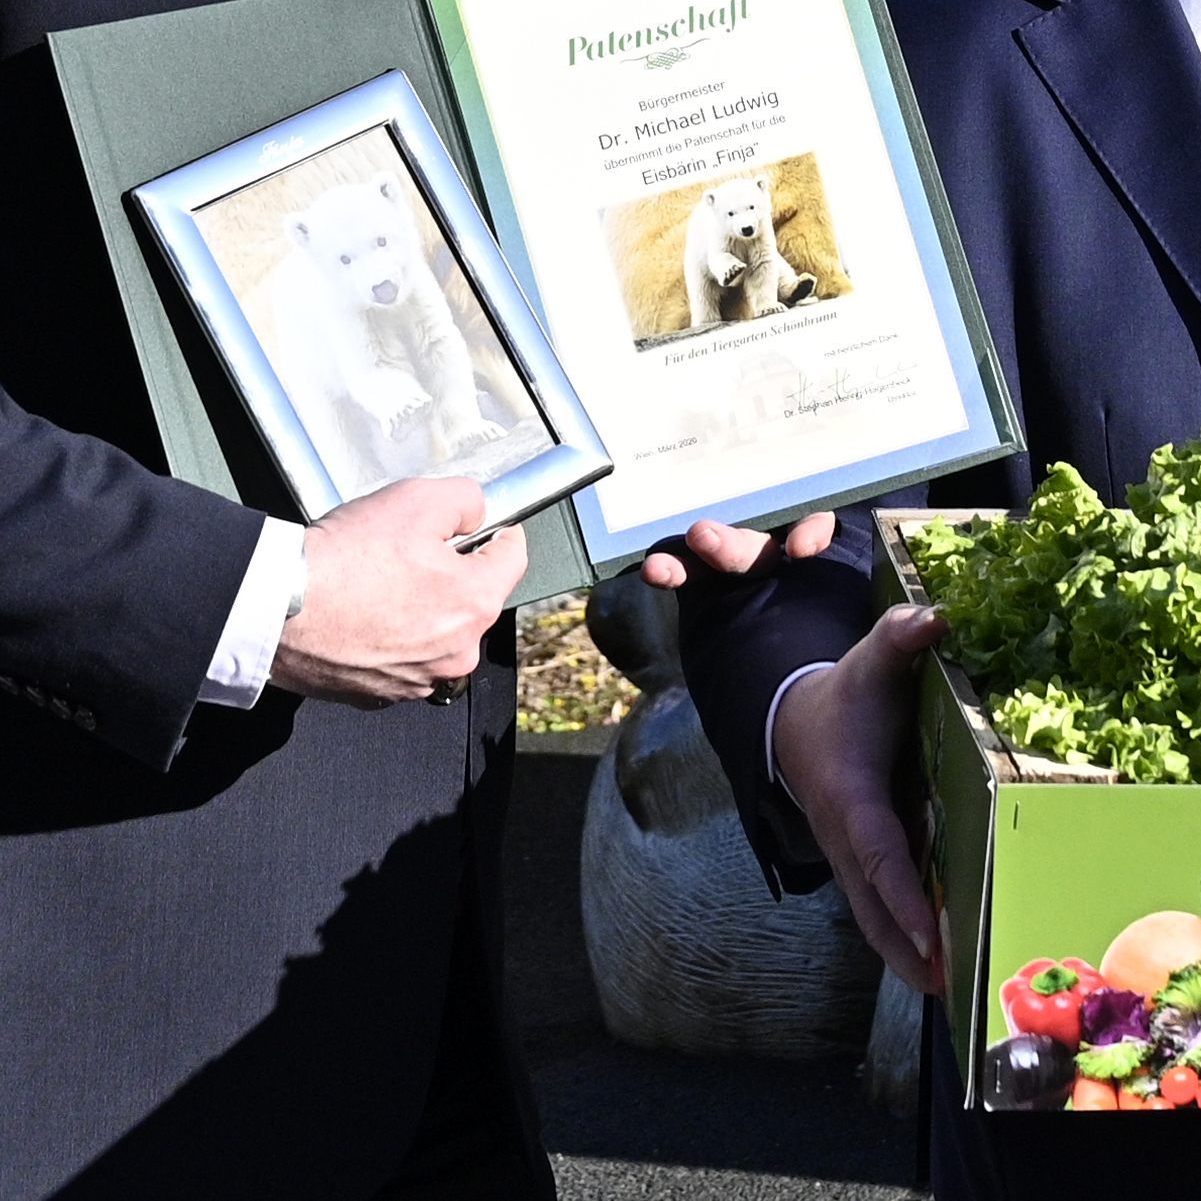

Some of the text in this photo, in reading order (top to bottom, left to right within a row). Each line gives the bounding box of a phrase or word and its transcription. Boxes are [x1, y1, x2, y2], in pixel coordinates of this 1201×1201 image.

[598, 91, 780, 151] Dr. Michael Ludwig
[638, 80, 726, 112] Bürgermeister
[603, 113, 787, 171] übernimmt die Patenschaft für die
[641, 157, 707, 185] Eisbärin
[665, 311, 838, 366] Für den Tiergarten Schönbrunn
